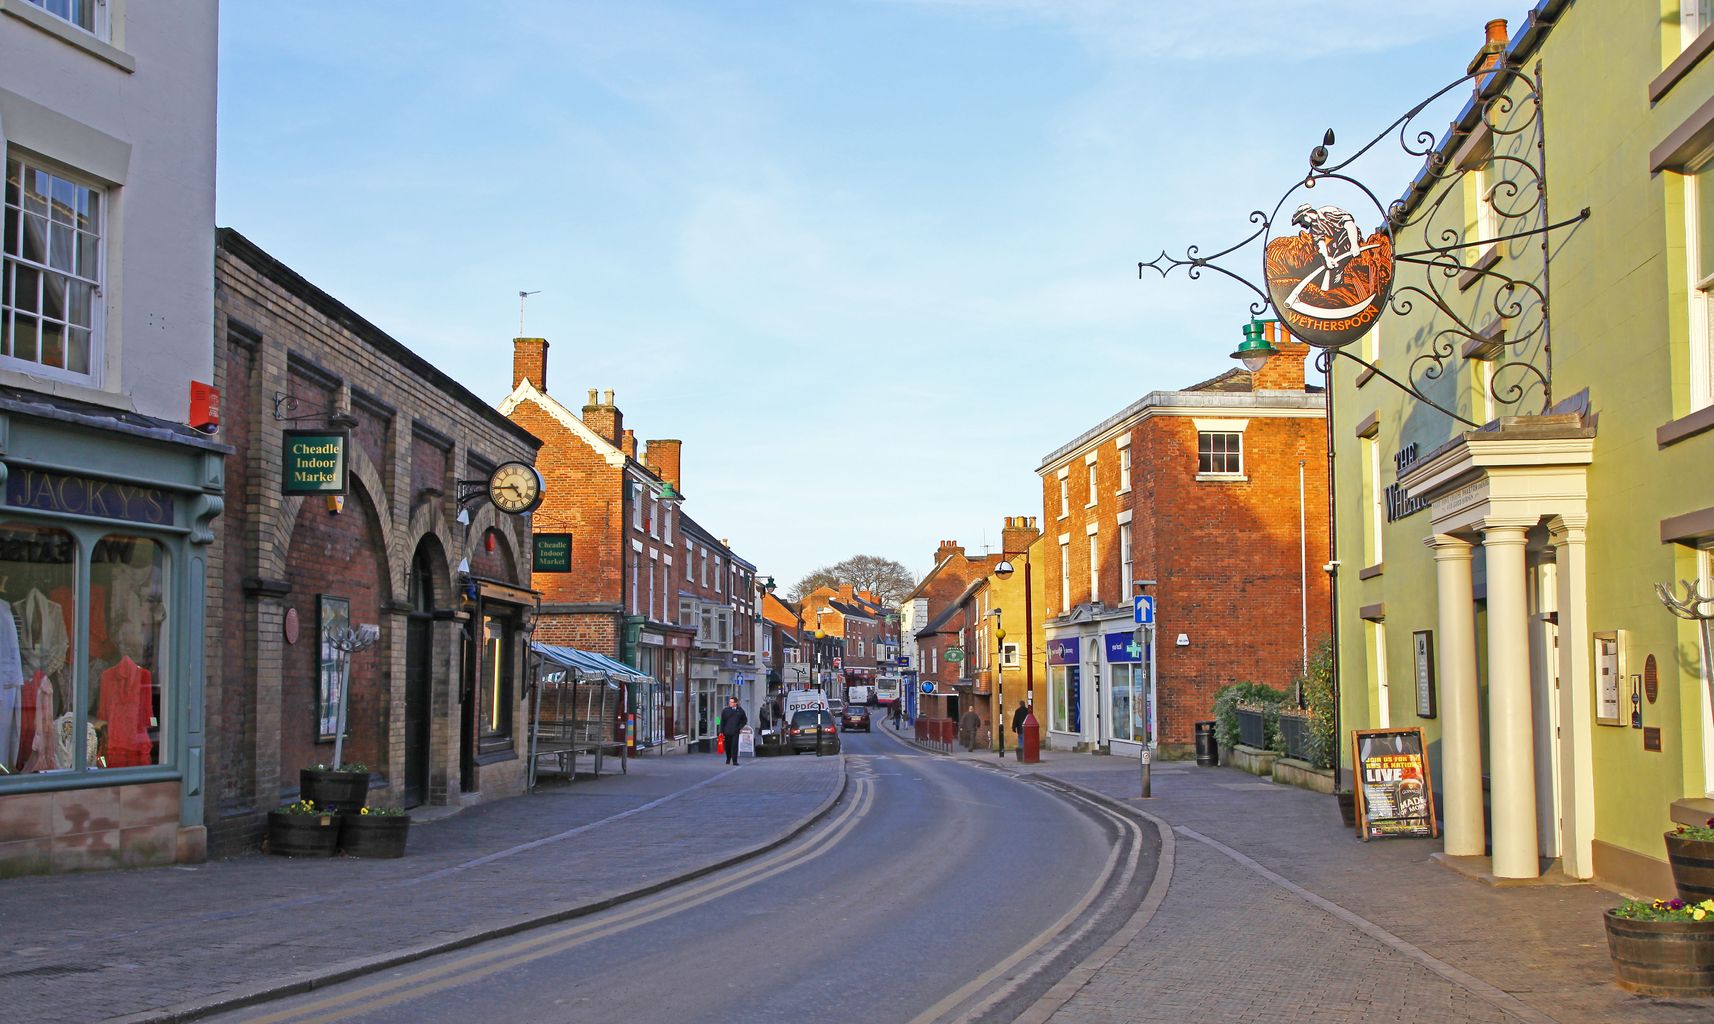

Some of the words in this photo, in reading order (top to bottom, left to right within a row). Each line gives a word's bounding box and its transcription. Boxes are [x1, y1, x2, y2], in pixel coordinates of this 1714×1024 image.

[1288, 304, 1379, 331] WETHERSPOON
[293, 443, 340, 455] Cheadle
[296, 458, 336, 468] Indoor
[294, 472, 337, 482] Market
[17, 469, 164, 522] JACKY'S
[1366, 768, 1402, 782] LIVE
[1400, 797, 1425, 810] MADE
